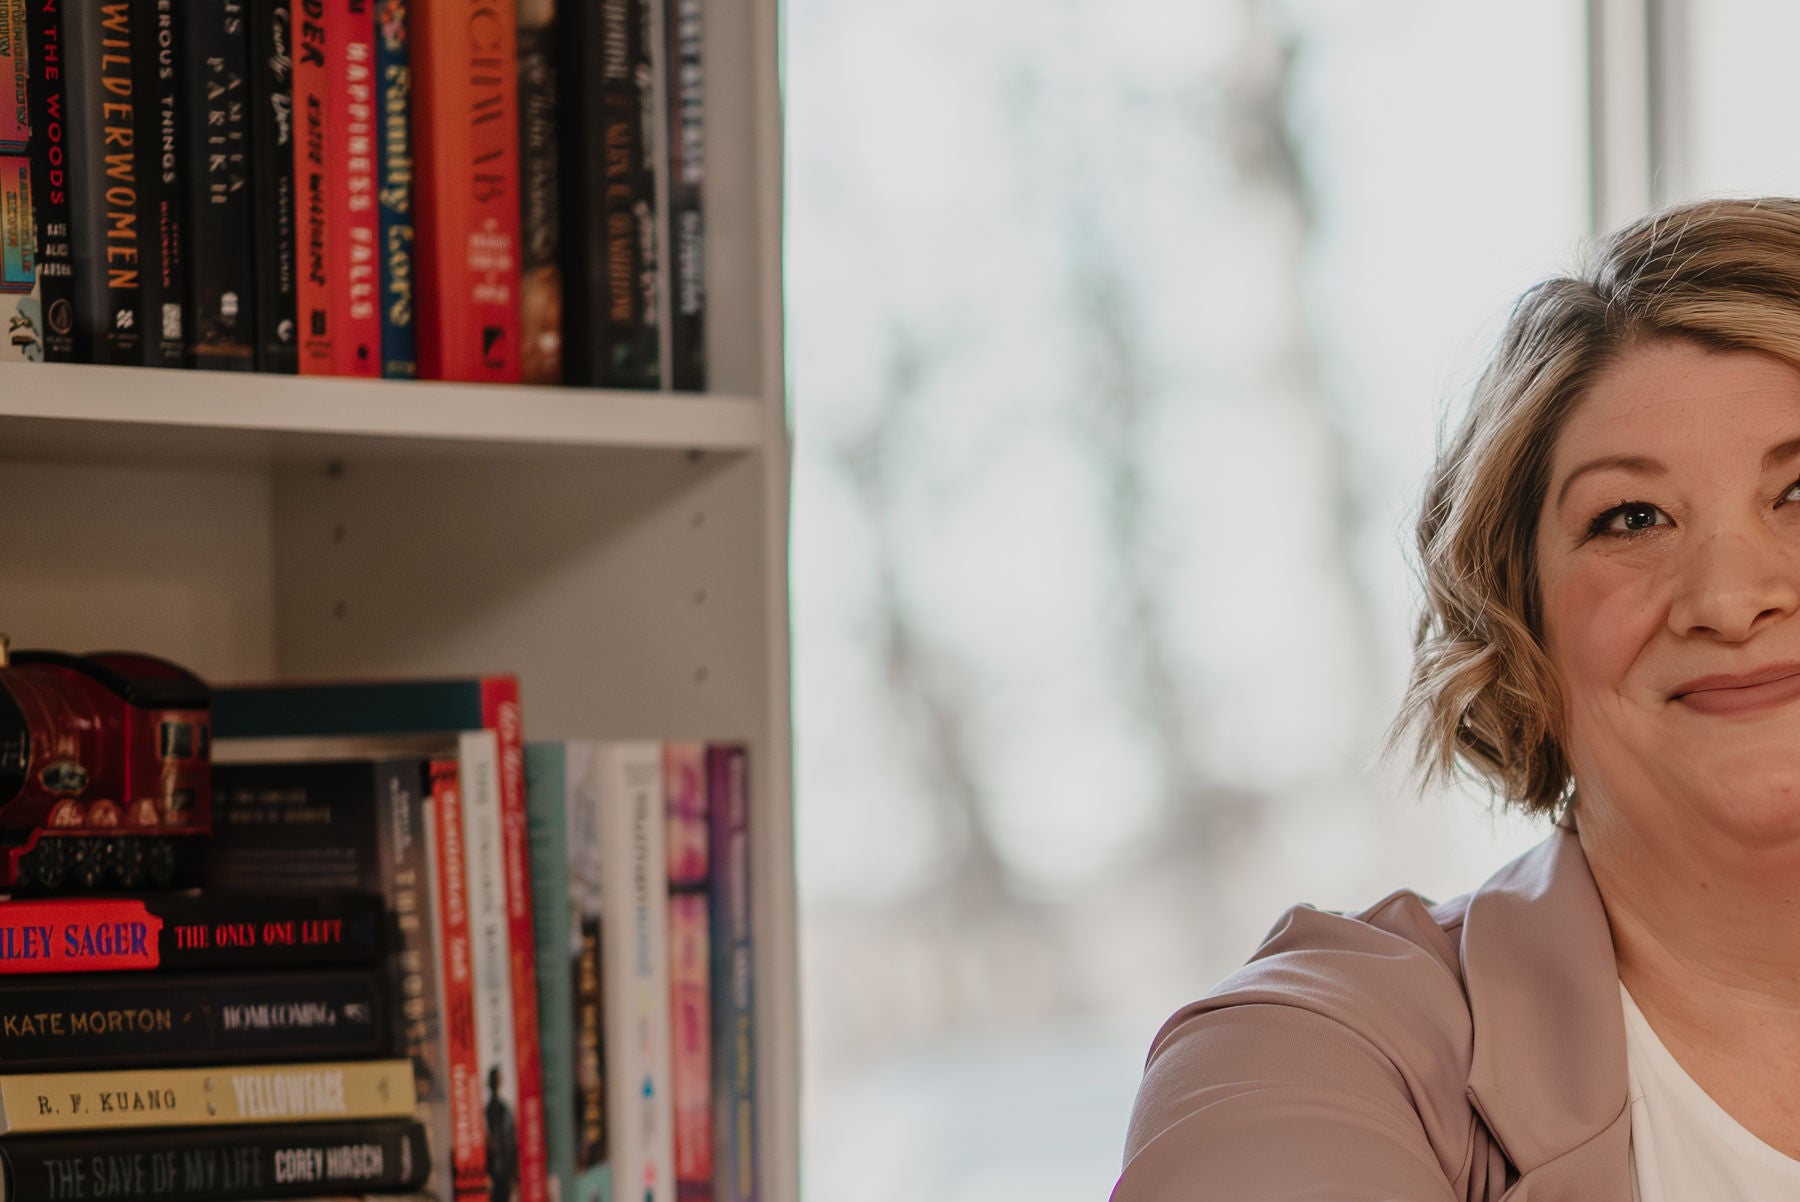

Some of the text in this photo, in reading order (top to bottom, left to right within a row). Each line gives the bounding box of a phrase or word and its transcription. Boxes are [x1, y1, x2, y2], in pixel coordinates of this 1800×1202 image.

[44, 24, 59, 80] THE
[347, 42, 371, 212] HAPPINESS
[469, 0, 505, 204] CHWAB
[46, 93, 64, 205] WOODS
[101, 3, 139, 290] WILDERWOMEN
[162, 93, 176, 184] THINGS
[380, 65, 415, 327] Family Lore
[350, 226, 374, 320] FALLS
[64, 921, 150, 959] SAGER
[174, 918, 343, 949] THE ONLY ONE LEFT
[3, 1008, 172, 1037] KATE MORTON
[222, 1001, 337, 1031] HOMECOMING
[37, 1089, 177, 1116] R. F. KUANG
[43, 1146, 263, 1200] THE SAVE OF MY LIFE
[274, 1143, 384, 1184] COREY HIRSCH
